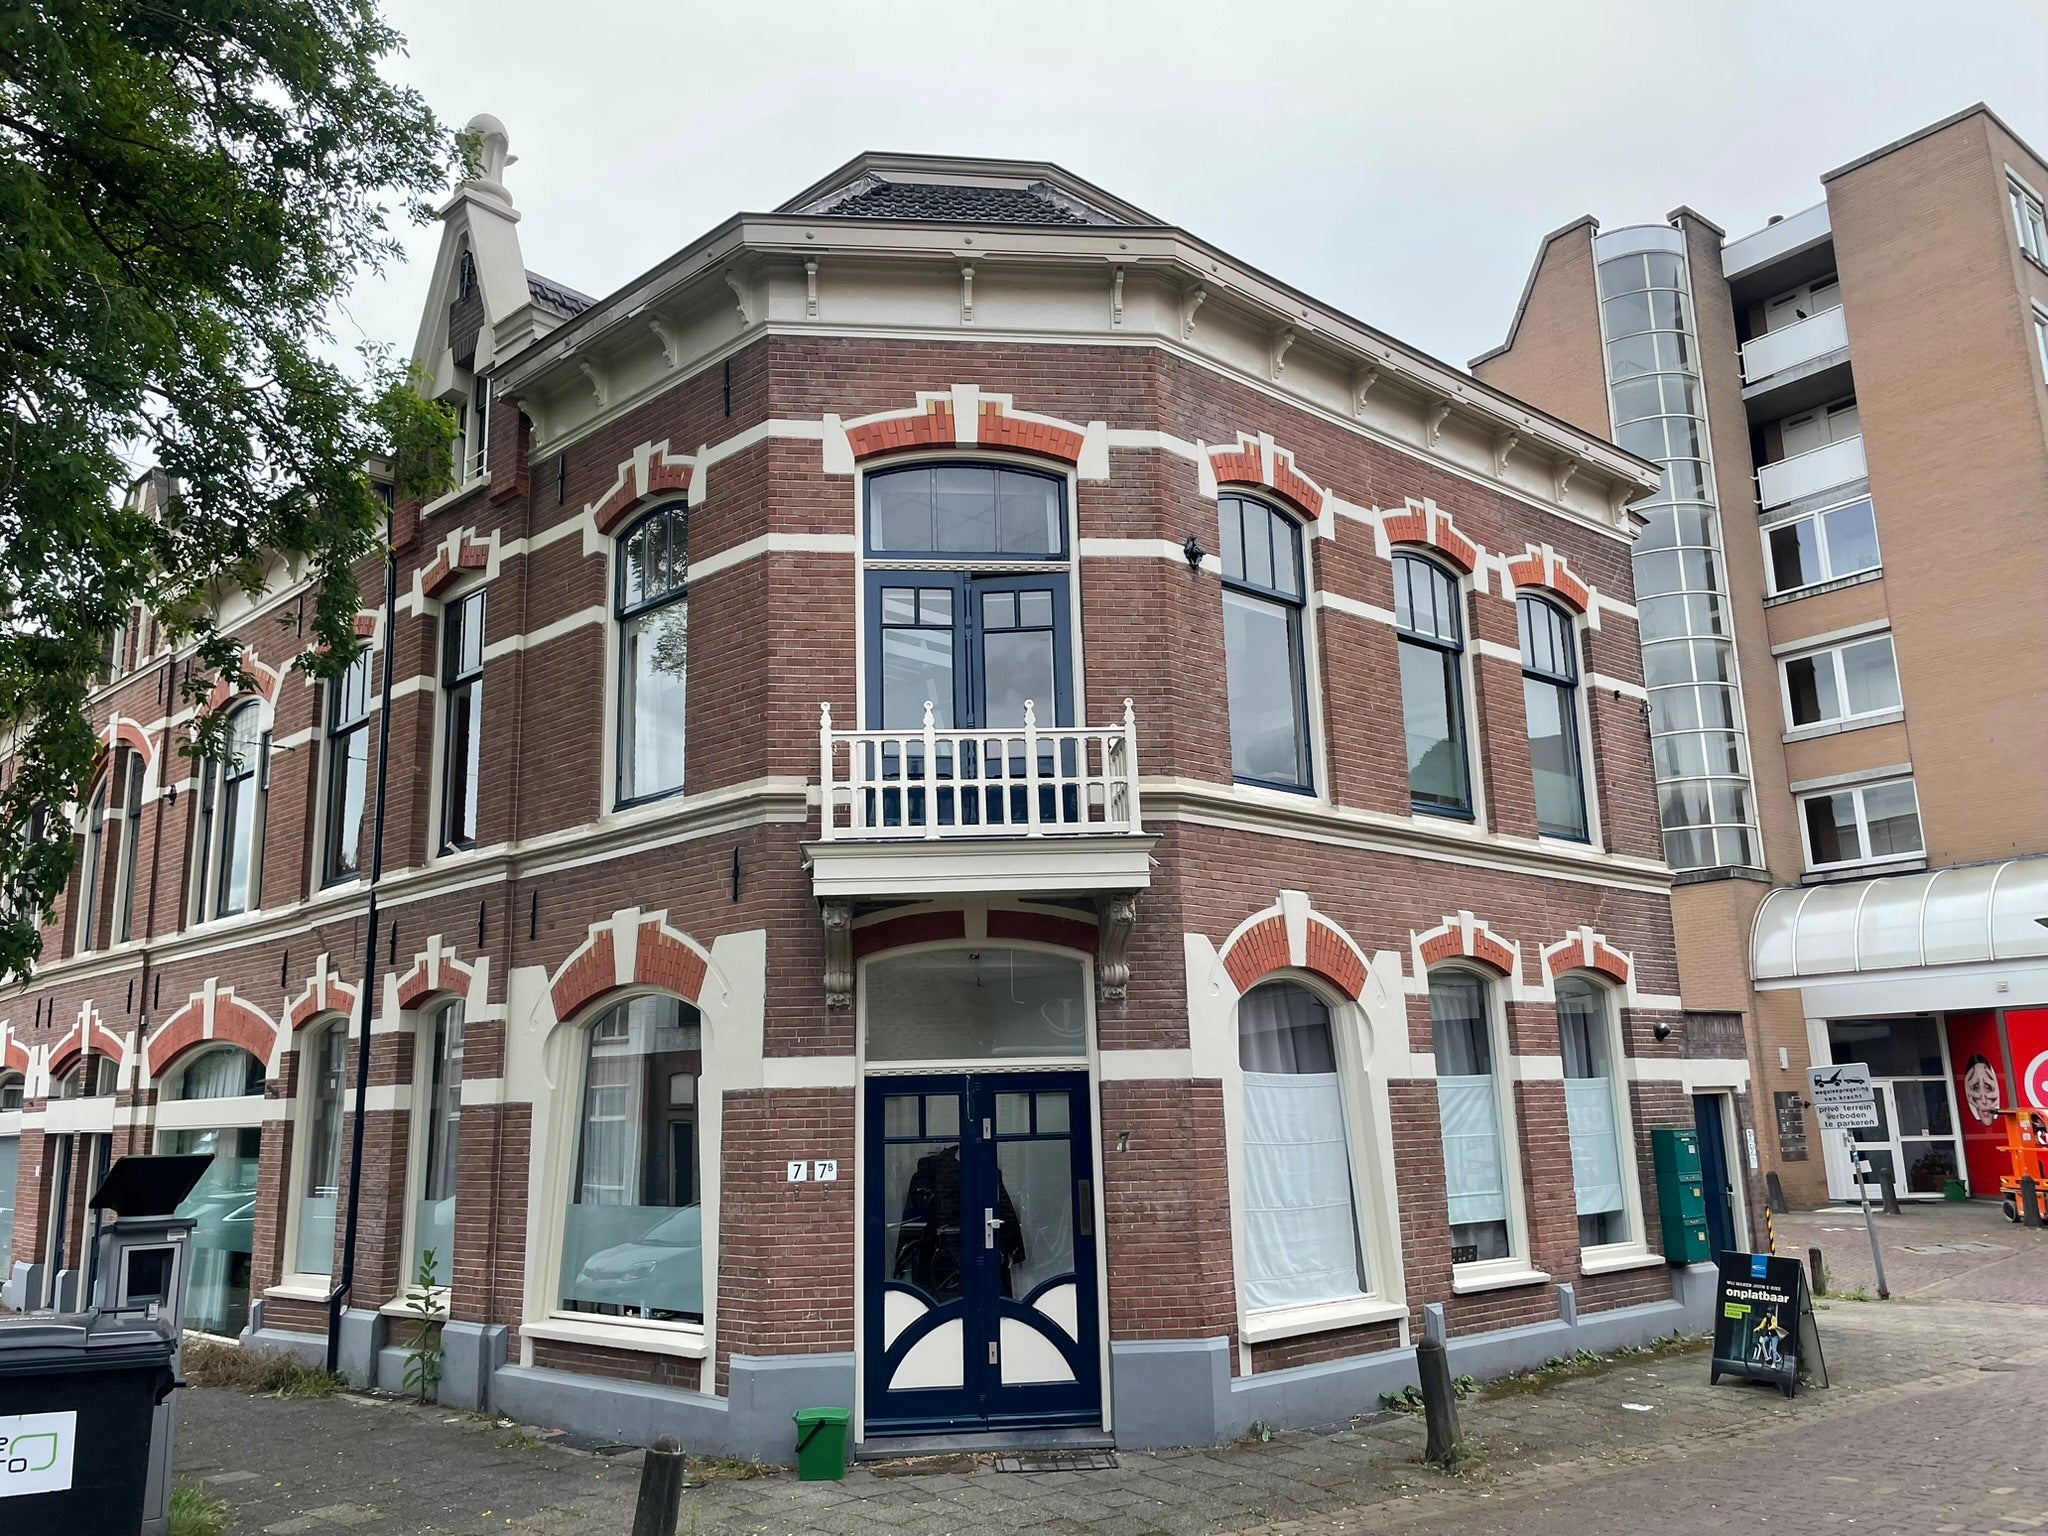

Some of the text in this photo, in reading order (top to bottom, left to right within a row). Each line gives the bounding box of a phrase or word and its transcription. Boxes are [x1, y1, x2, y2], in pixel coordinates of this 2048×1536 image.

[1819, 1105, 1839, 1114] privé
[1826, 1112, 1866, 1120] verboden
[1837, 1119, 1875, 1128] parkeren
[1119, 1131, 1130, 1152] 7
[793, 1164, 801, 1179] 7
[1726, 1289, 1789, 1303] onplatbaar
